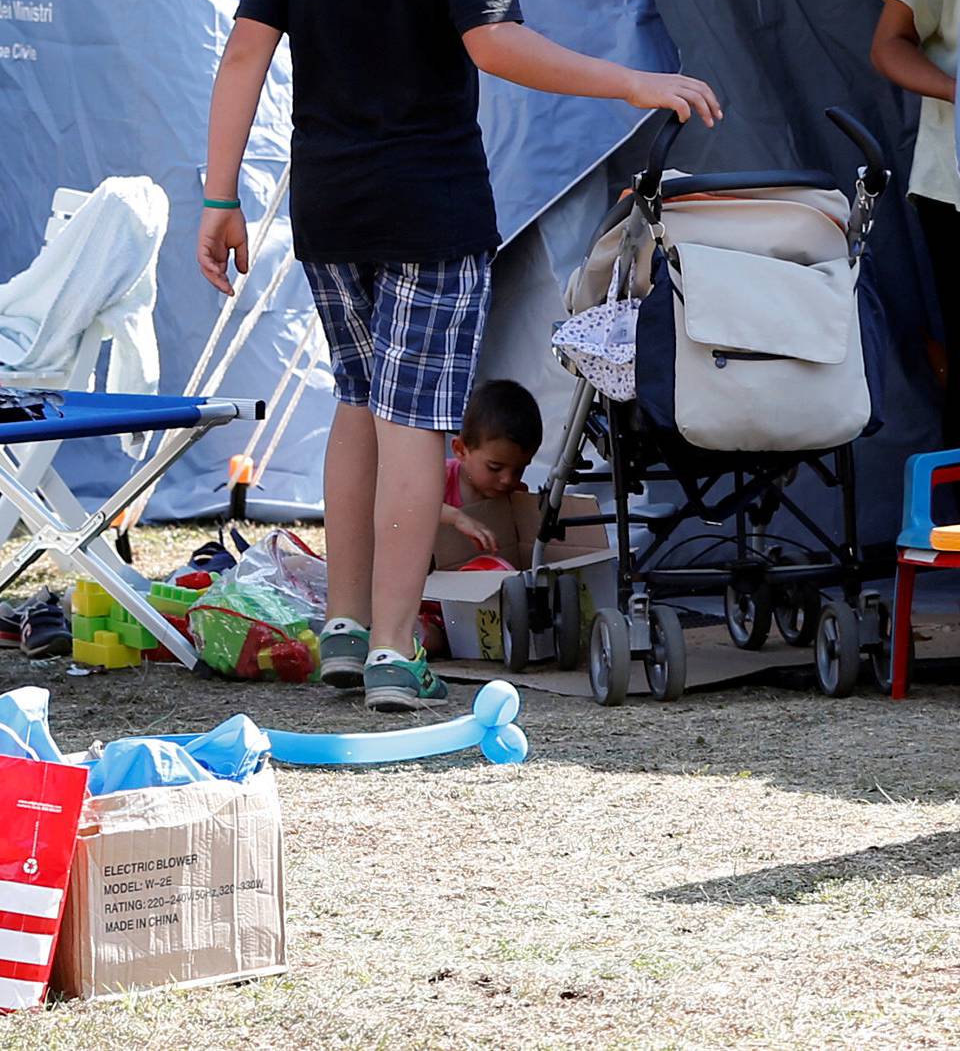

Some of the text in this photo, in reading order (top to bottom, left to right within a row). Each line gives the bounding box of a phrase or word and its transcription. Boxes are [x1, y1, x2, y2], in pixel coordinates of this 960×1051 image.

[104, 853, 198, 877] ELECTRIC BLOWER
[104, 876, 172, 895] MODEL: W-2E
[104, 899, 146, 914] RATING:
[105, 913, 179, 933] MADE IN CHINA
